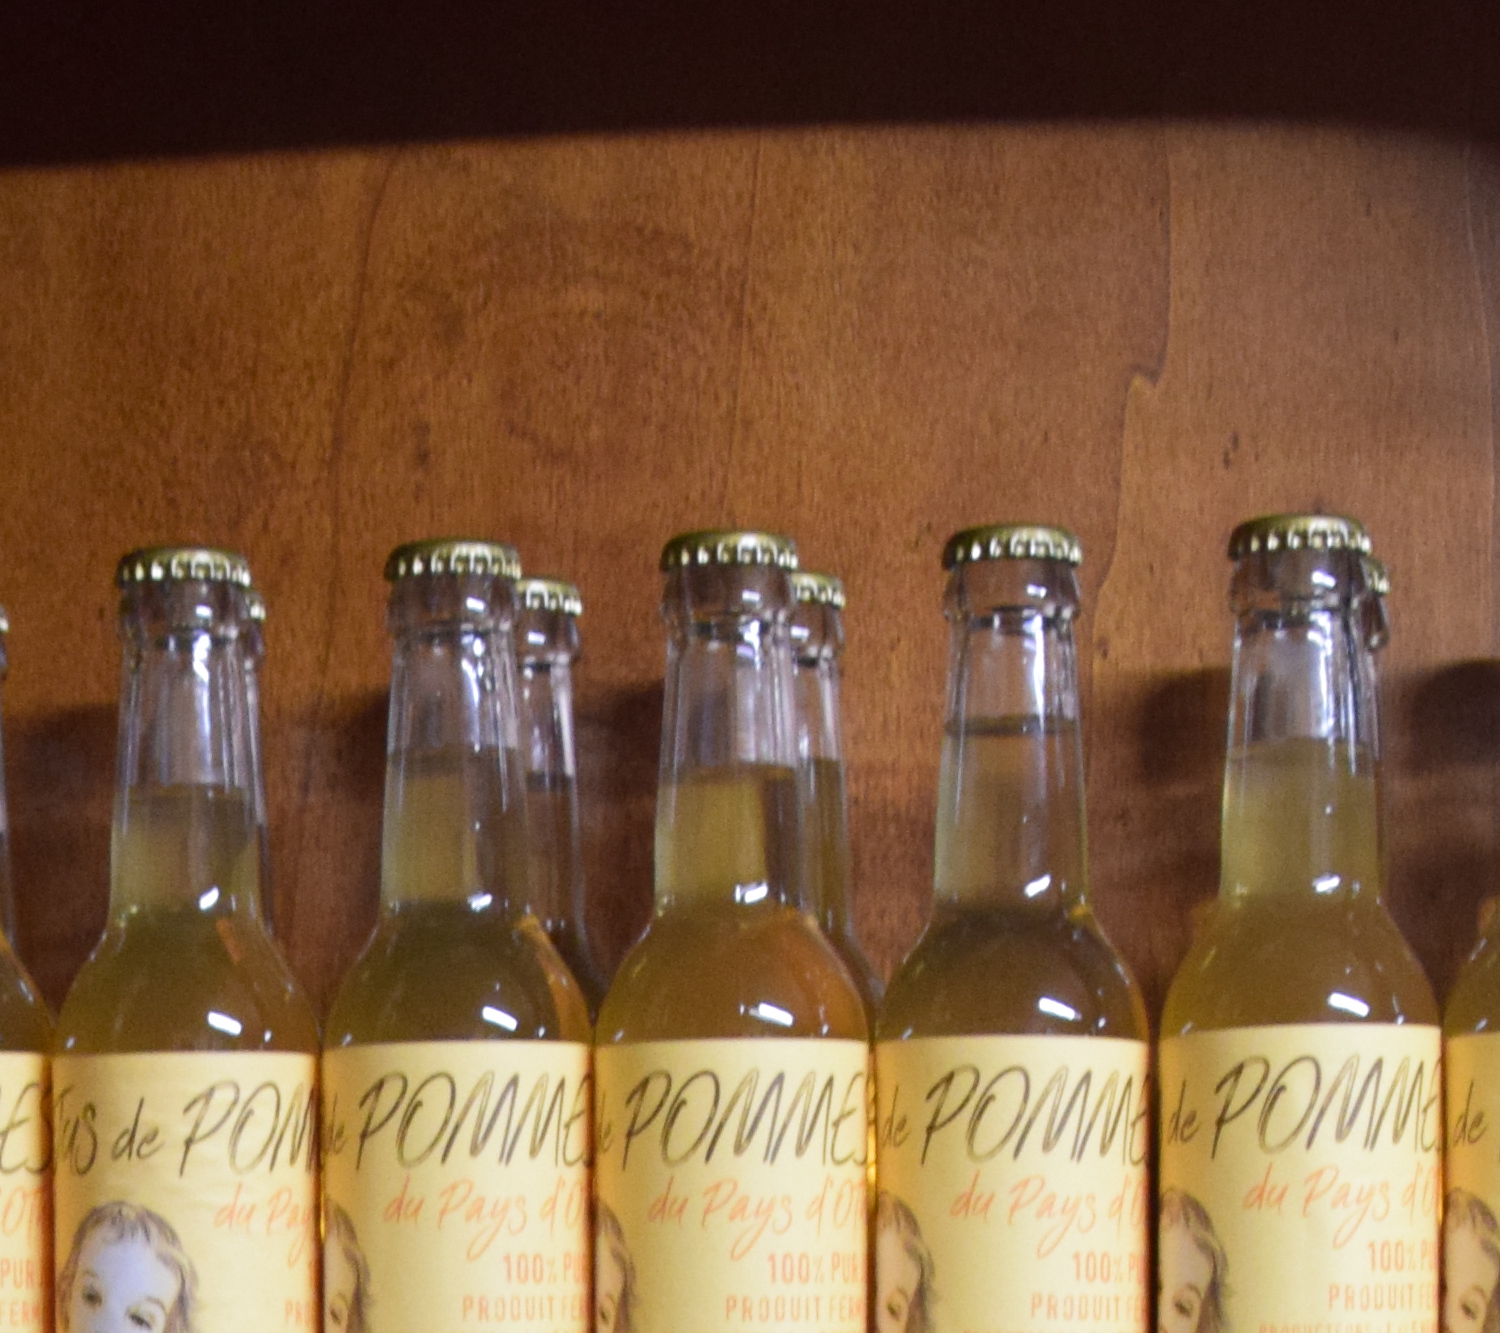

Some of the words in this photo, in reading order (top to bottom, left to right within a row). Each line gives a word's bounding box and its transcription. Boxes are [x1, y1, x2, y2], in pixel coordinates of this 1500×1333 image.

[111, 1096, 165, 1162] de
[883, 1085, 909, 1147] de
[1168, 1078, 1200, 1143] de
[1453, 1080, 1487, 1147] de
[214, 1182, 254, 1229] du
[383, 1174, 425, 1224] du
[438, 1178, 527, 1261] Pays
[649, 1175, 688, 1226] du
[702, 1178, 793, 1261] Pays
[950, 1169, 995, 1224] du
[1009, 1173, 1096, 1259] Pays
[1243, 1161, 1289, 1214] du
[1302, 1164, 1390, 1249] Pays
[504, 1253, 557, 1283] 100%
[768, 1253, 824, 1284] 100%
[831, 1252, 858, 1284] PUR
[1073, 1251, 1122, 1284] 100%
[1369, 1240, 1415, 1272] 100%
[463, 1295, 555, 1322] PRODUIT
[726, 1295, 820, 1322] PRODUIT
[1031, 1293, 1121, 1321] PRODUIT
[1329, 1283, 1414, 1311] PRODUIT
